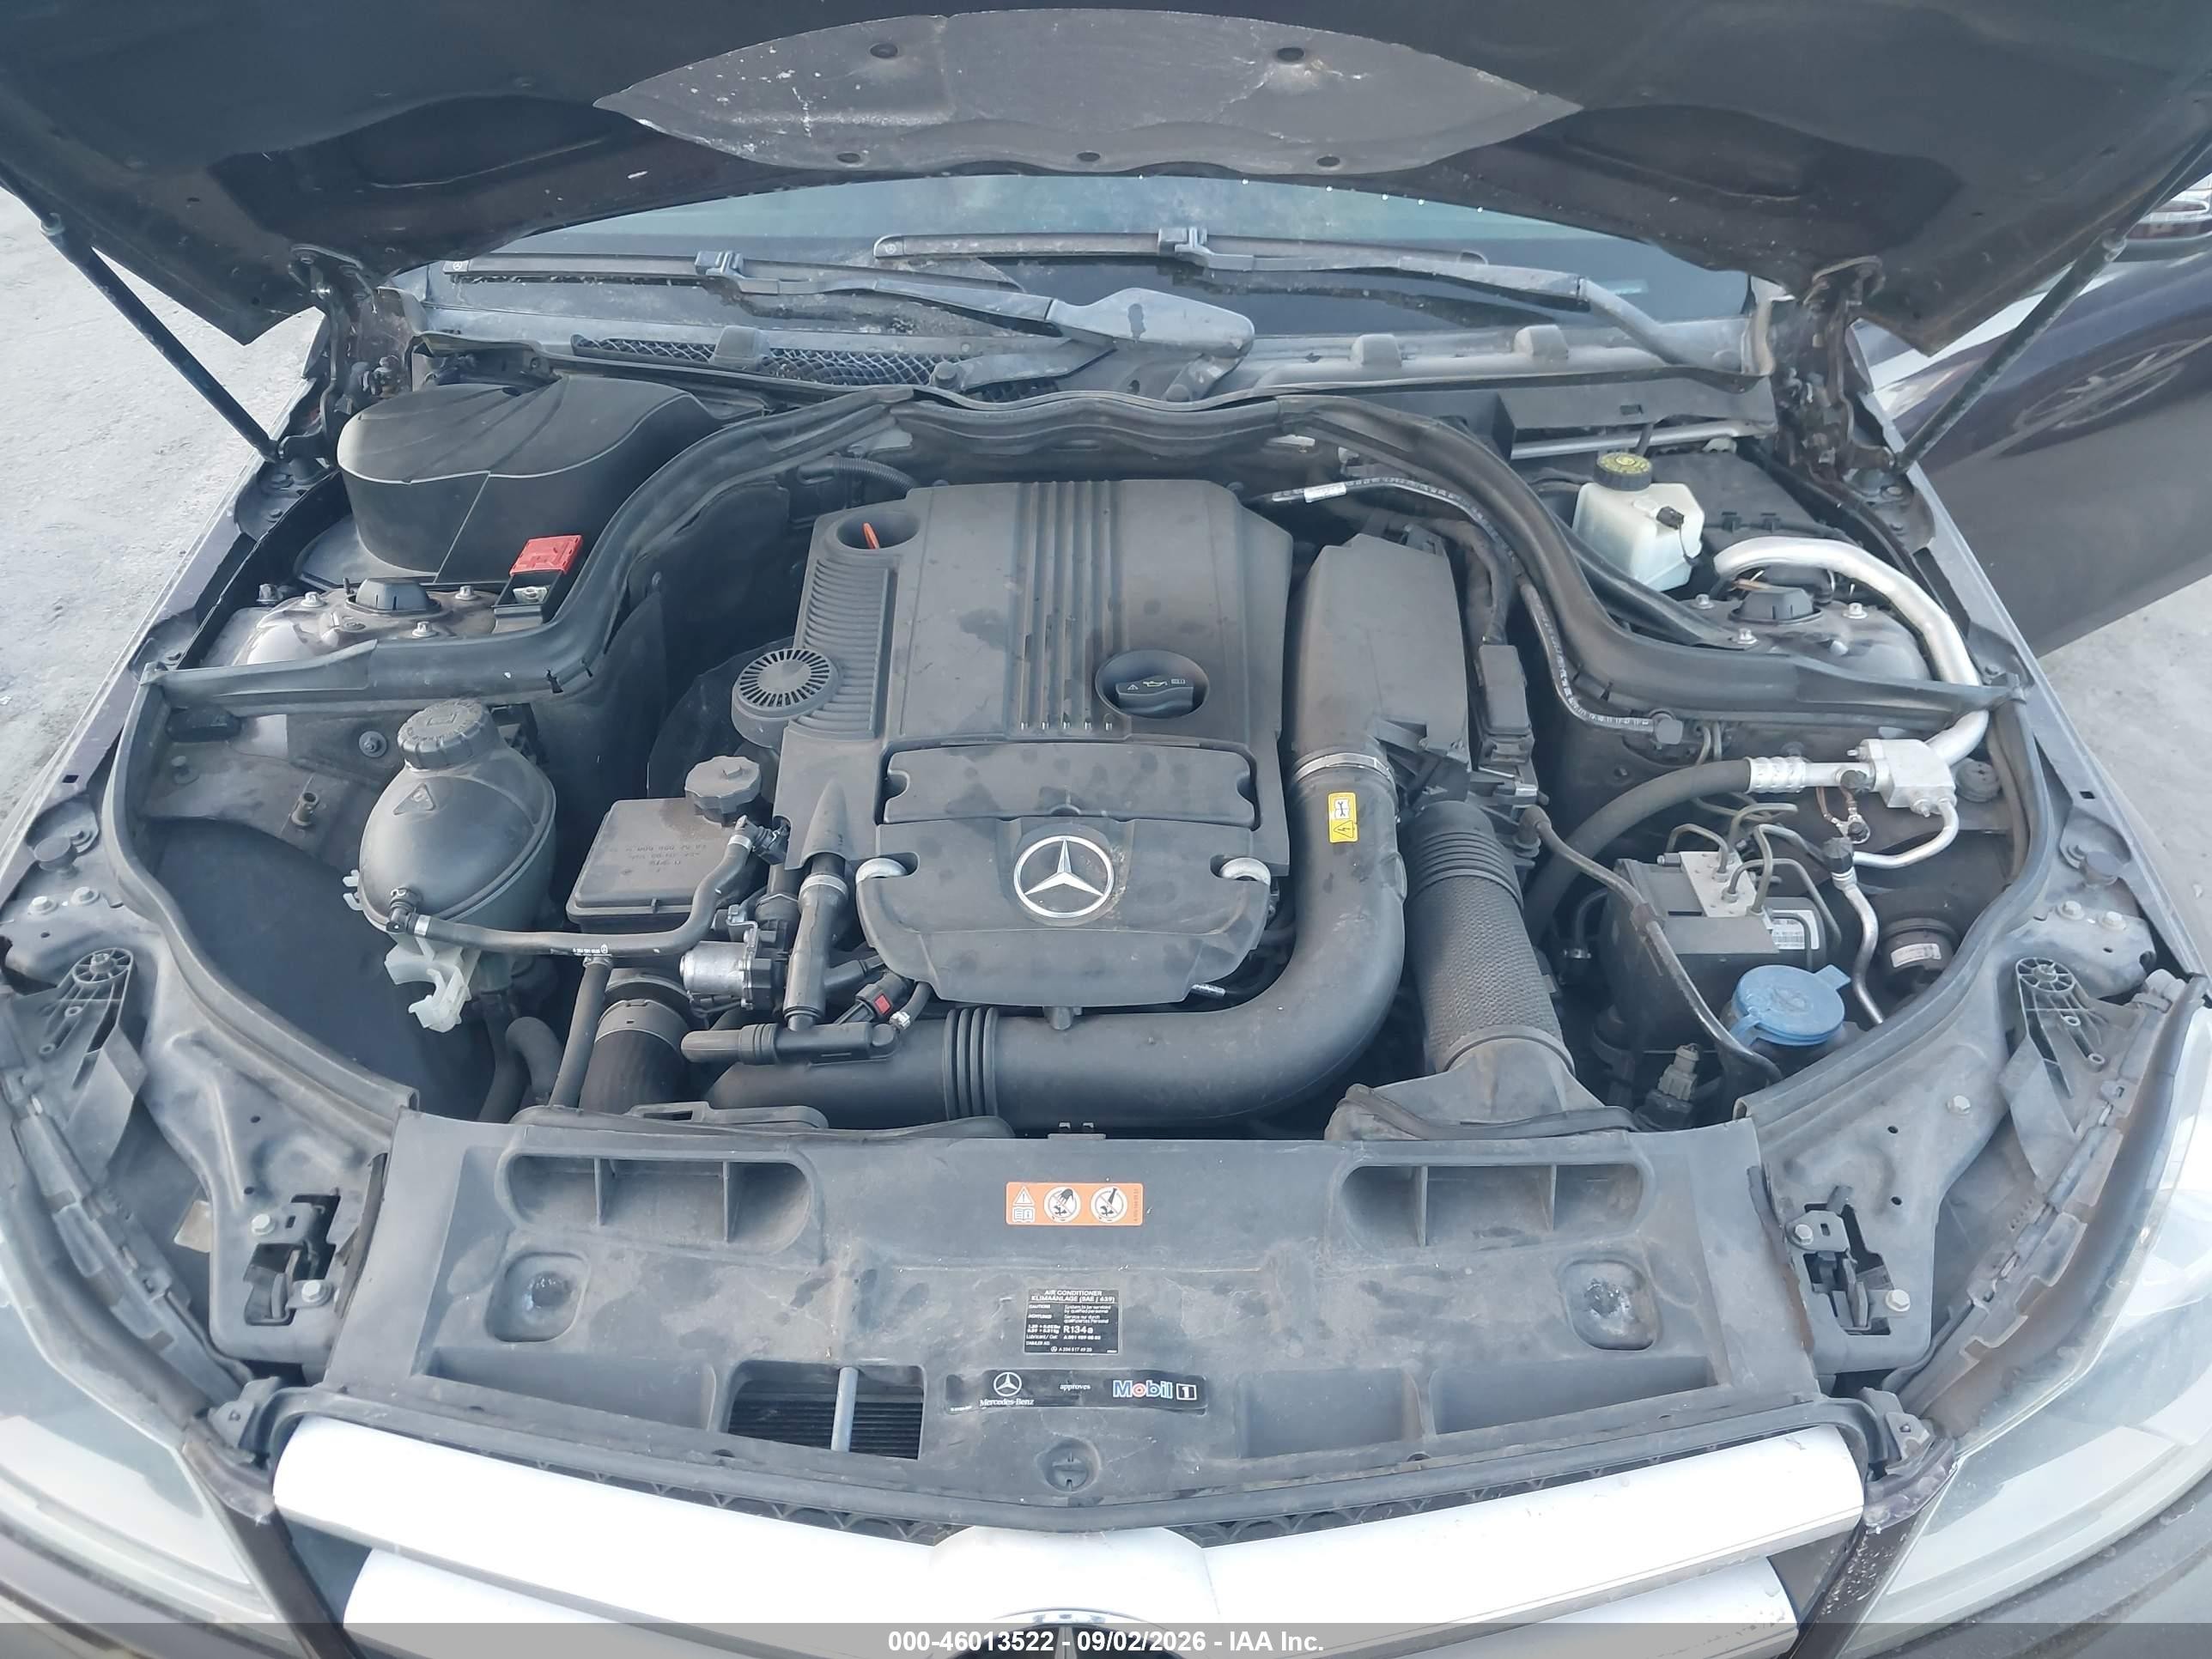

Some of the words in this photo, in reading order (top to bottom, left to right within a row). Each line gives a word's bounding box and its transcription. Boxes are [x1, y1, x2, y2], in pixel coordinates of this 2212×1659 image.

[1063, 1325, 1094, 1334] R134a
[1112, 1380, 1174, 1400] Mobil
[979, 1399, 1035, 1407] Mercedes-Benz
